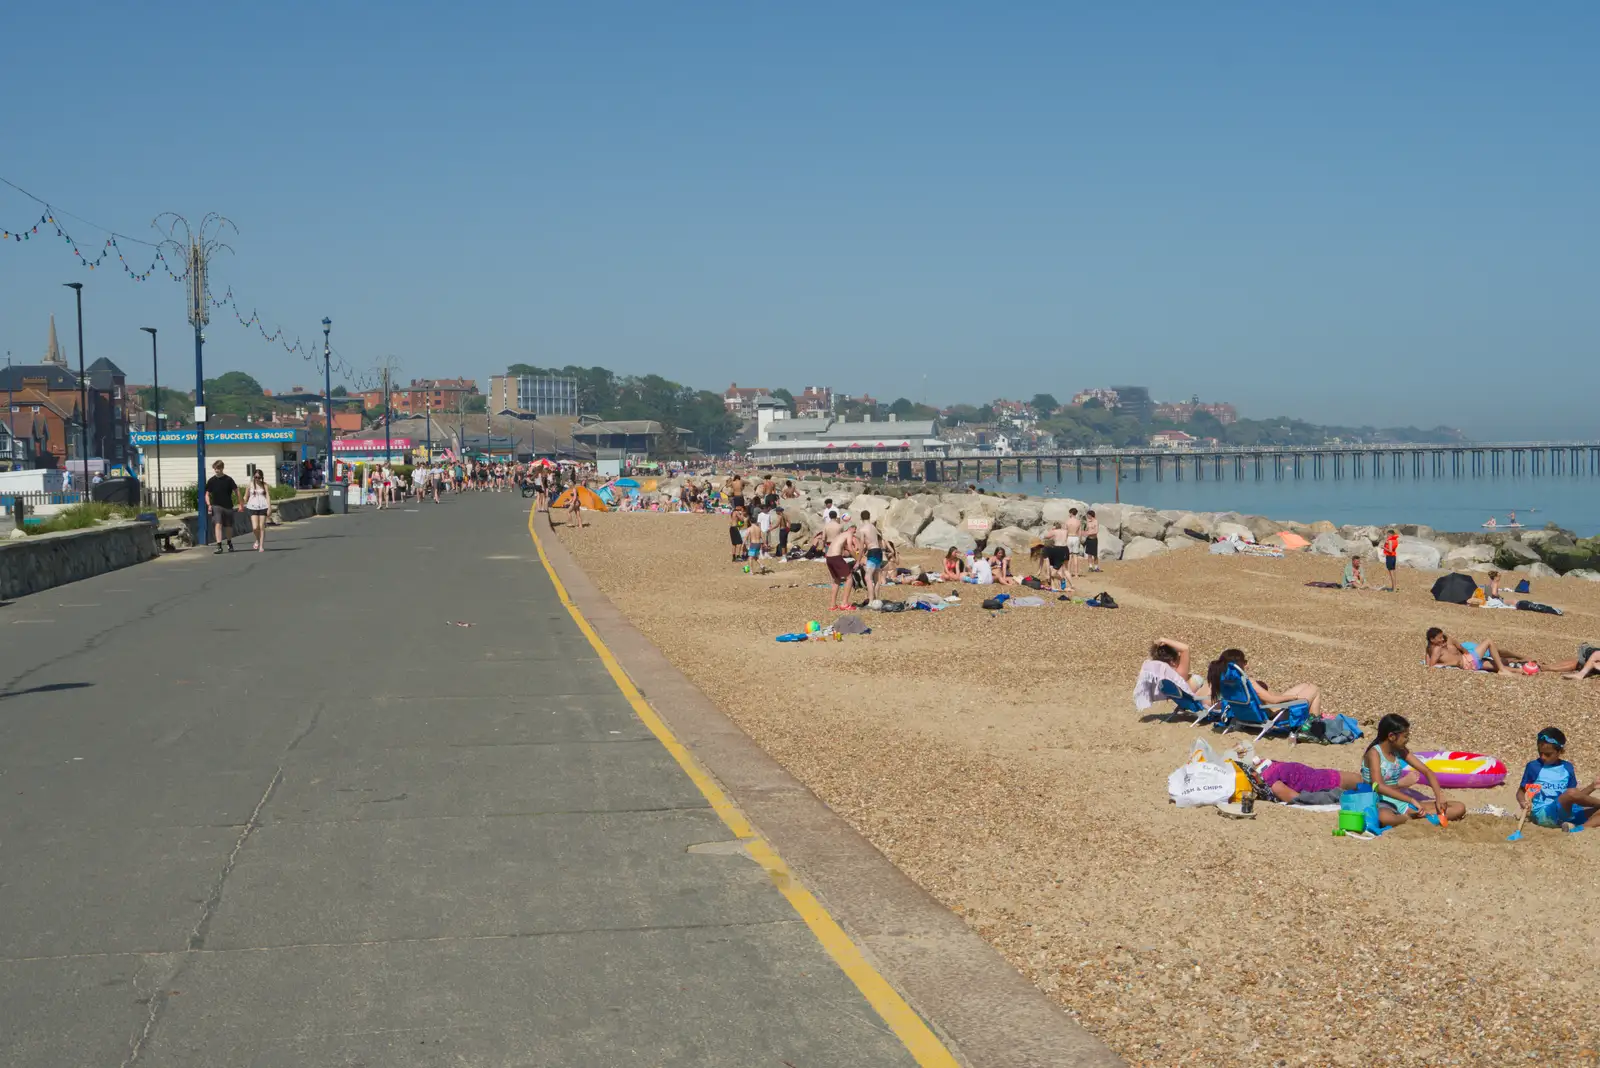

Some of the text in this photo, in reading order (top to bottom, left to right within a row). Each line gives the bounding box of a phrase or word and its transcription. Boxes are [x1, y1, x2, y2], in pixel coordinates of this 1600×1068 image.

[185, 433, 215, 441] SWTS
[220, 432, 253, 440] BUCKETS
[261, 431, 288, 439] SPADES
